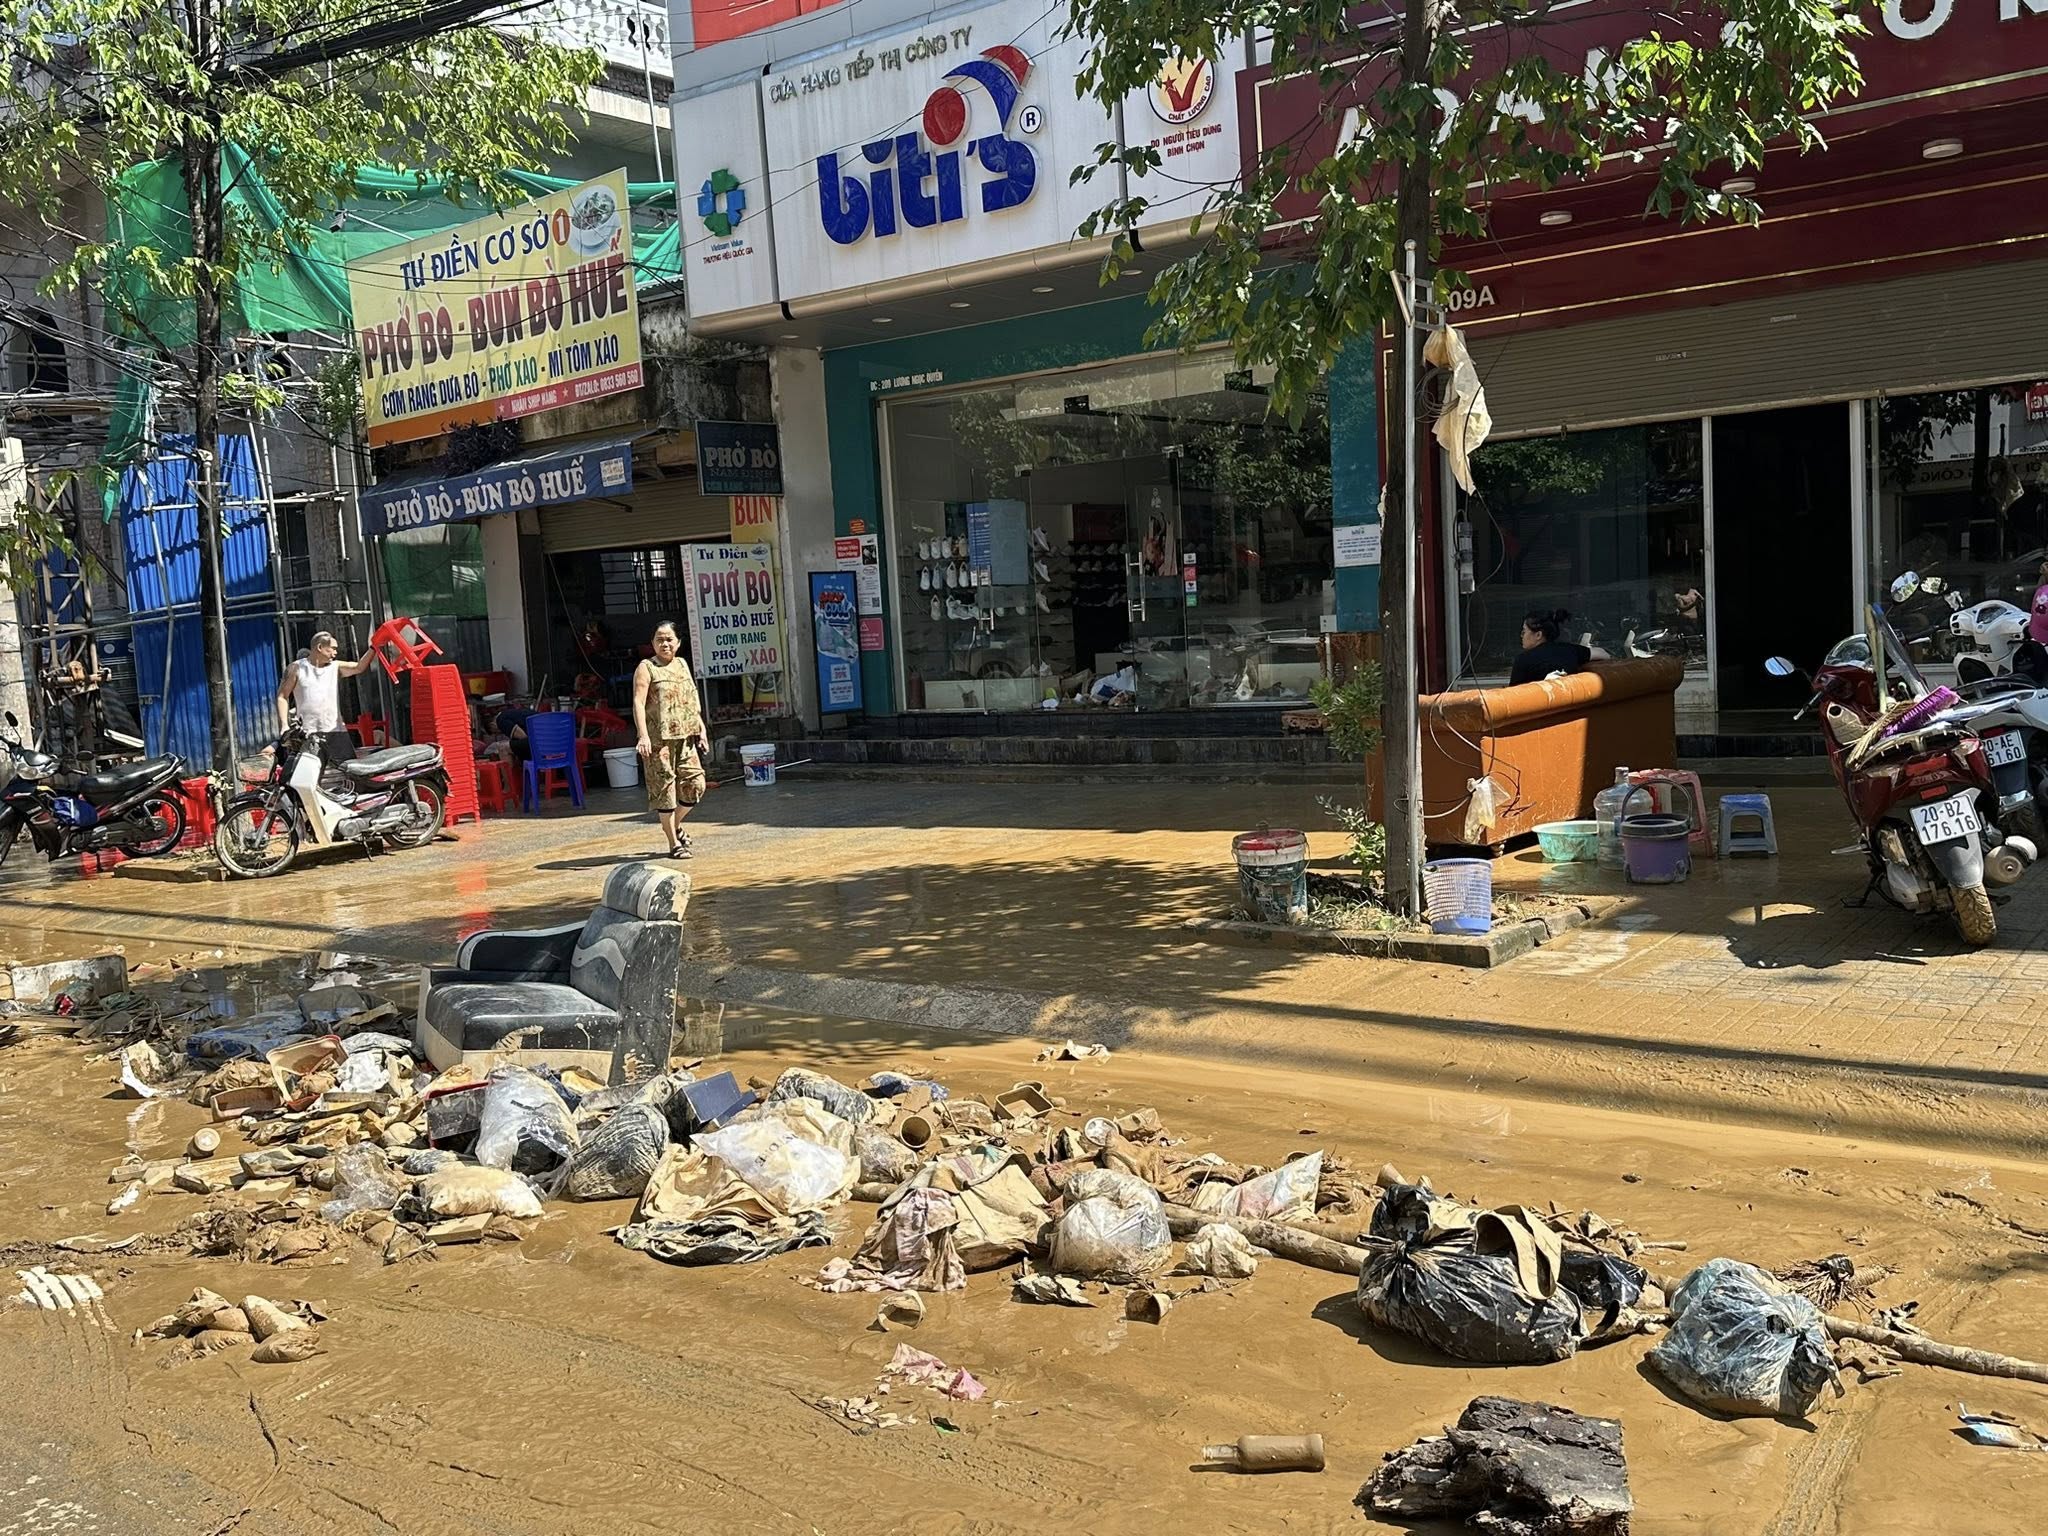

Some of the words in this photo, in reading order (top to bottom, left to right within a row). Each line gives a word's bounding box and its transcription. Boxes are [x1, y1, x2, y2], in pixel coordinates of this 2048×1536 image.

[904, 35, 947, 63] CÔNG
[950, 25, 972, 49] TY
[1151, 139, 1160, 148] DO
[1163, 131, 1185, 146] NGƯỜI
[1186, 128, 1200, 140] TIÊU
[1186, 140, 1205, 153] CHỌN
[400, 252, 426, 290] TƯ
[431, 233, 479, 282] ĐIỀN
[485, 225, 515, 264] CƠ
[521, 209, 550, 254] SỞ
[362, 297, 413, 379] PHỞ
[417, 292, 454, 365] BÒ
[468, 276, 523, 352] BÚN
[526, 258, 564, 337] BÒ
[567, 228, 629, 325] HUẾ
[1446, 285, 1496, 314] 09A
[382, 389, 407, 418] CƠM
[407, 382, 438, 412] RANG
[463, 365, 479, 399] BÒ
[489, 352, 512, 393] PHỞ
[514, 353, 538, 387] XÀO
[548, 344, 564, 378] MÌ
[566, 339, 592, 373] TÔM
[594, 331, 619, 366] XÀO
[704, 440, 746, 467] PHỞ
[750, 442, 777, 468] BÒ
[384, 488, 424, 528] PHỞ
[425, 485, 453, 521] BÒ
[461, 477, 504, 514] BÚN
[507, 468, 535, 507] BÒ
[539, 455, 586, 501] HUẾ
[697, 548, 714, 560] Tư
[698, 562, 740, 608] PHỞ
[745, 562, 772, 605] BÒ
[703, 612, 729, 630] BÚN
[732, 610, 747, 628] BÒ
[750, 606, 774, 627] HUẾ
[716, 632, 738, 646] CƠM
[741, 631, 767, 644] RANG
[712, 646, 738, 660] PHỞ
[749, 645, 777, 666] XÀO
[1987, 747, 2022, 766] 61.60
[1920, 800, 1964, 824] 20-B2
[1922, 815, 1976, 842] 176.16
